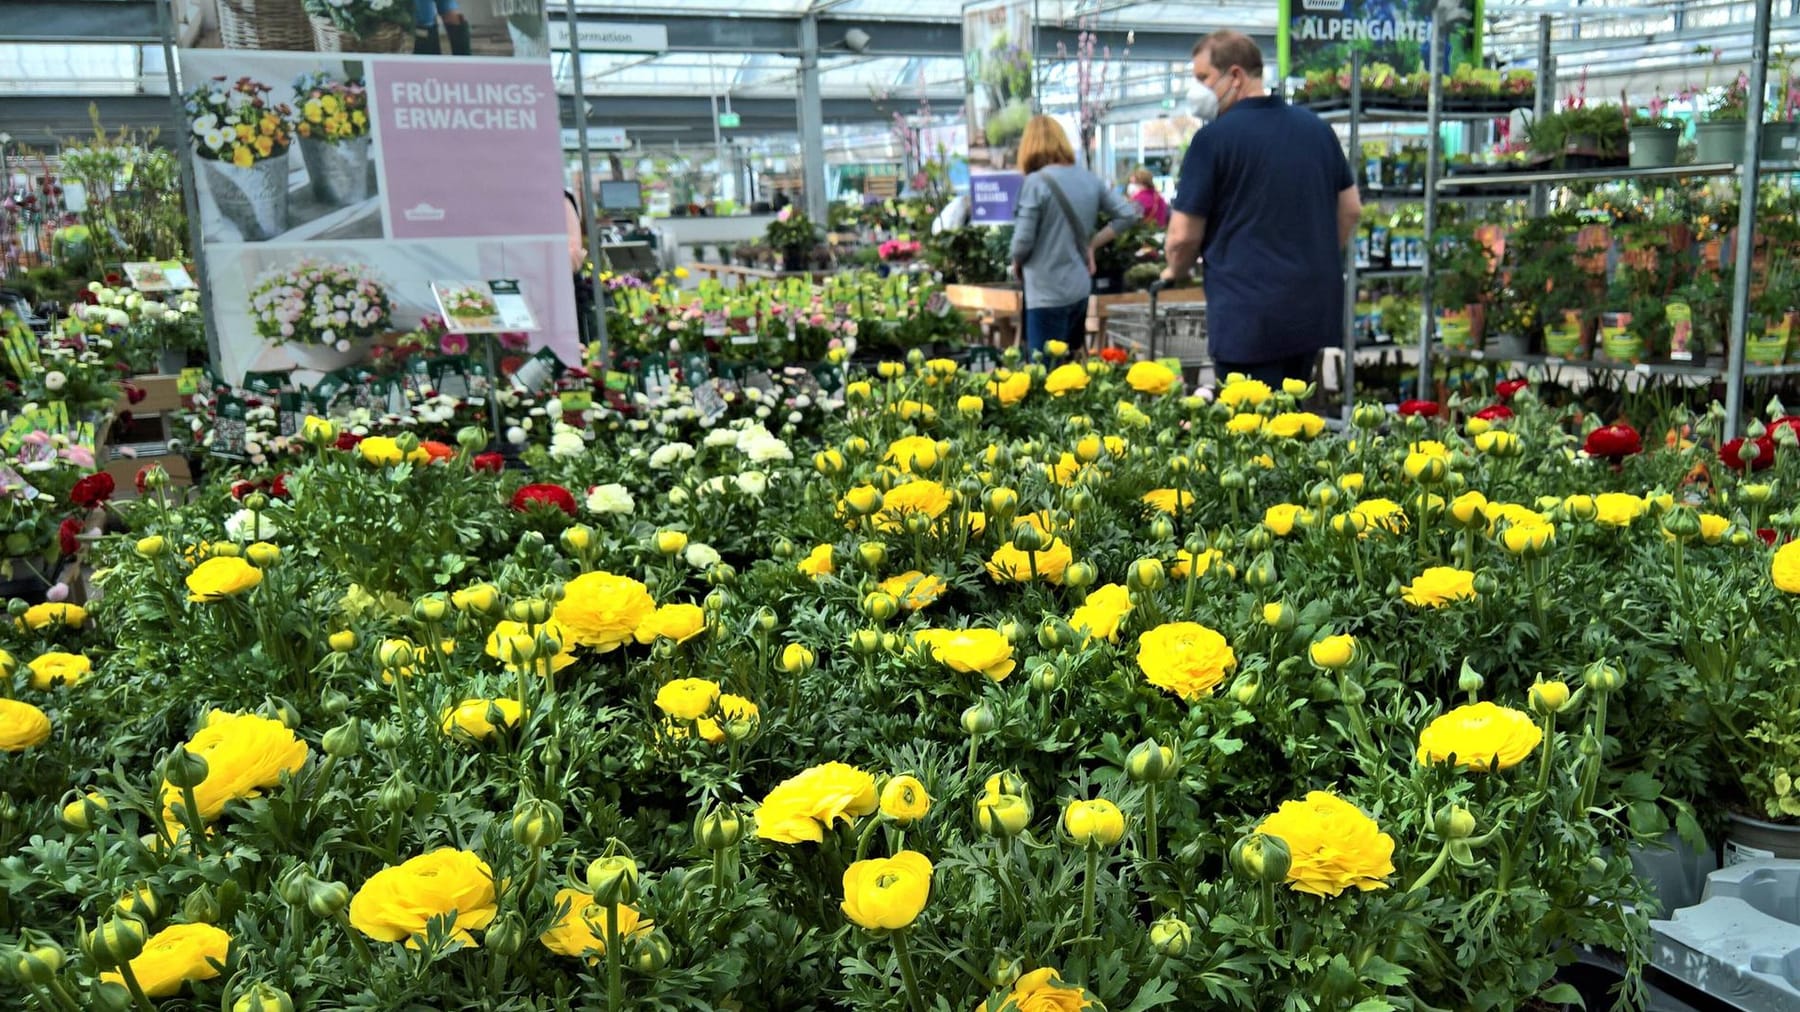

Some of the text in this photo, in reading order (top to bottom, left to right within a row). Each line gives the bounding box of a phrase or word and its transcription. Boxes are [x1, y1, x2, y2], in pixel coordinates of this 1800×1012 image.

[559, 28, 633, 42] Inormation
[391, 78, 545, 105] FRÜHLINGS-
[394, 107, 537, 129] ERWACHEN
